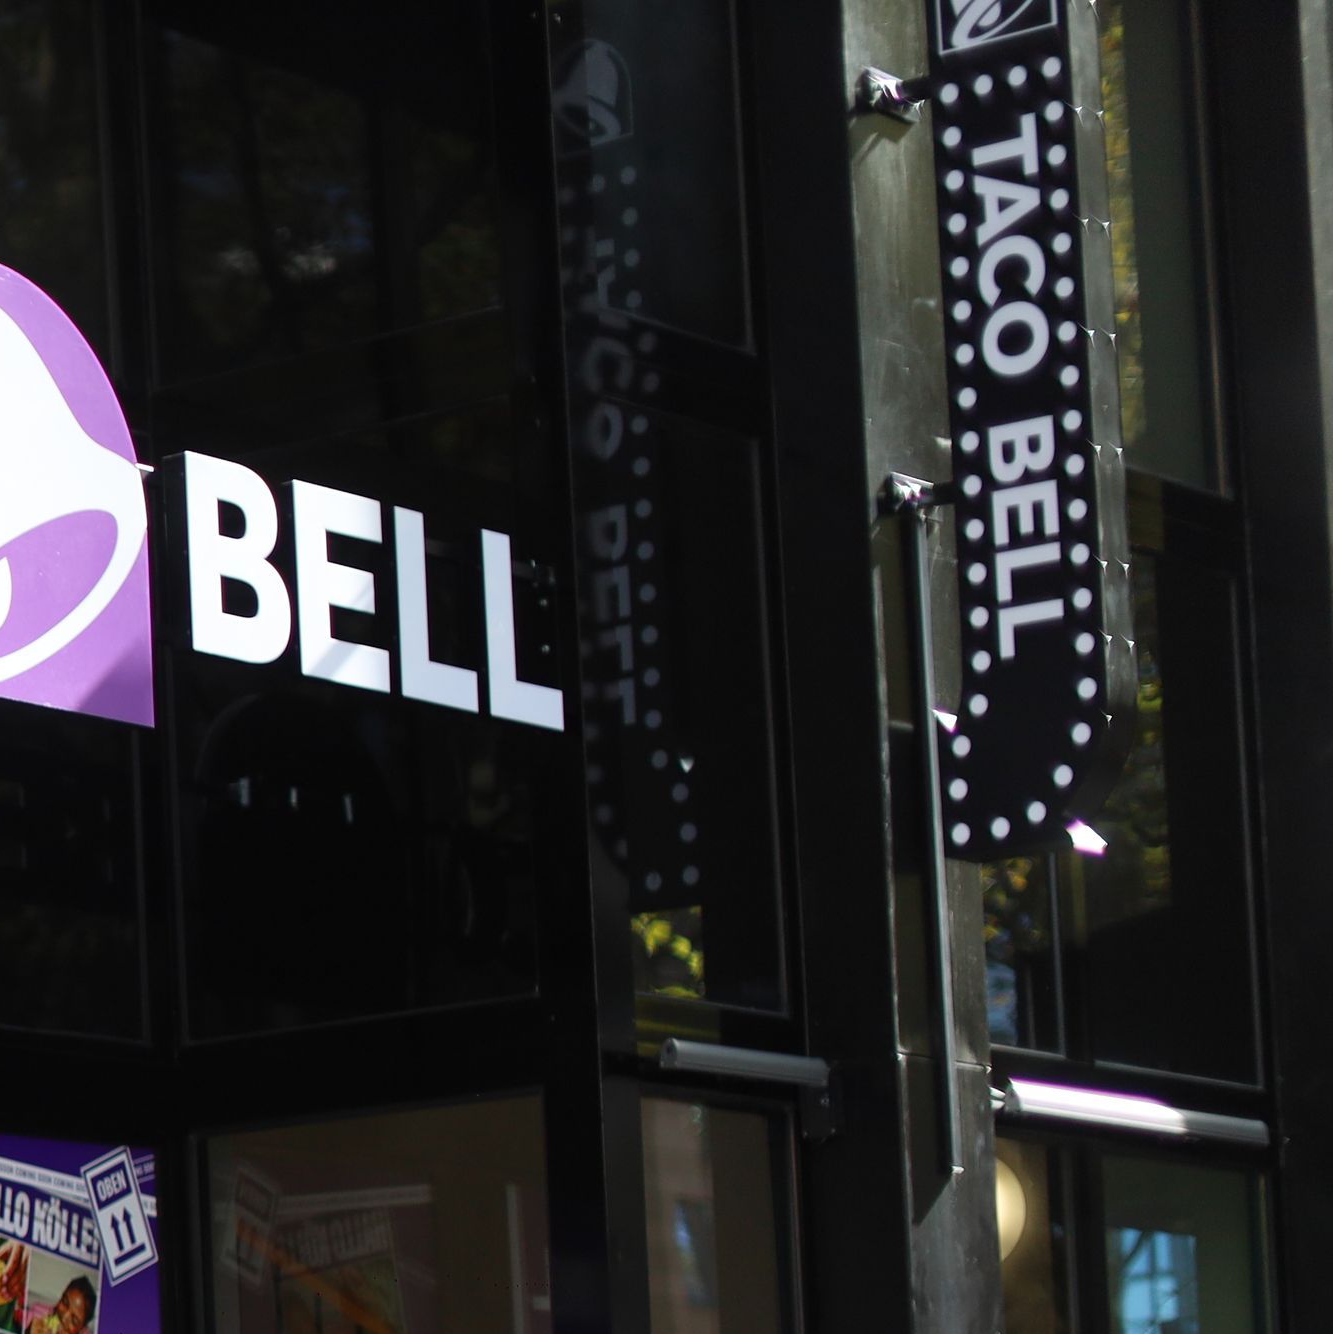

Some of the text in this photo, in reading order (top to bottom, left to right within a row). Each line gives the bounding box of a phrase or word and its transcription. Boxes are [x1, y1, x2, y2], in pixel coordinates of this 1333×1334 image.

[972, 113, 1065, 660] TACO BELL
[183, 451, 564, 731] BELL
[96, 1169, 127, 1202] OBEN
